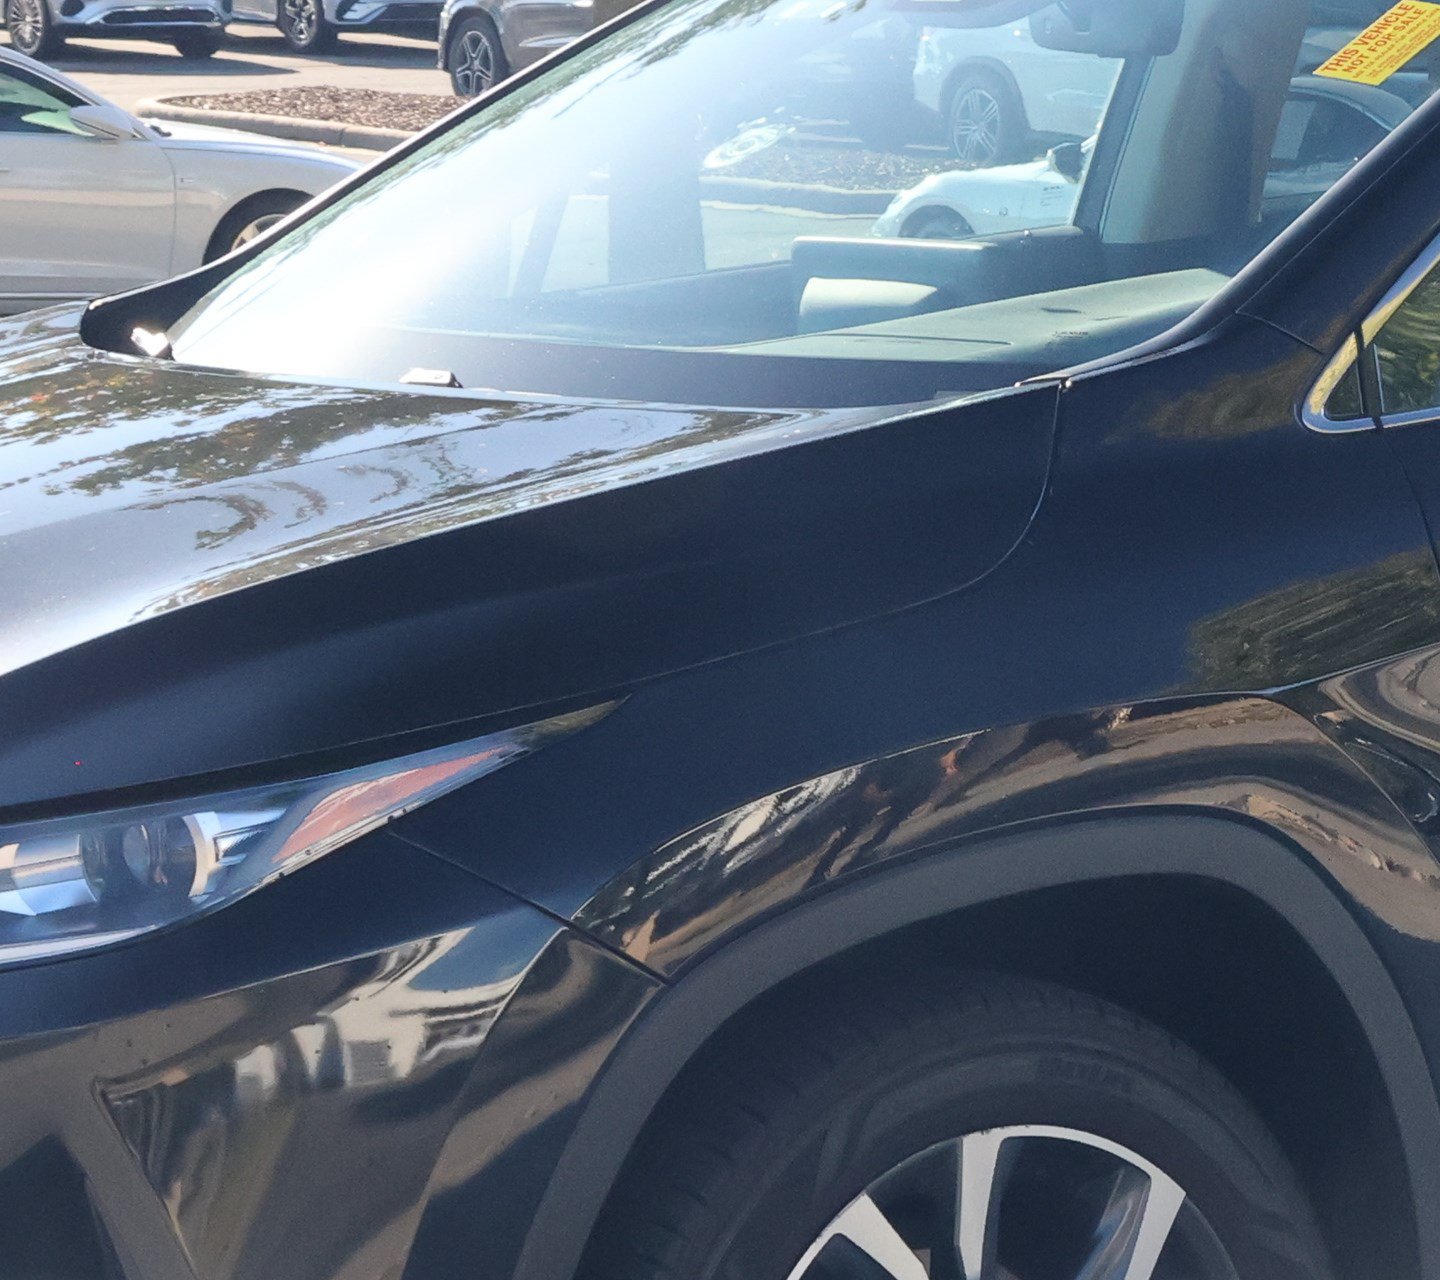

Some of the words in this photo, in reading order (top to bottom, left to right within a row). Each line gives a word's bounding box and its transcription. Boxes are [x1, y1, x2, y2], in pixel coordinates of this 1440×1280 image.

[1323, 48, 1359, 72] THIS
[1353, 3, 1416, 47] VEHICLE
[1342, 53, 1369, 73] NOT
[1368, 32, 1395, 53] FOR
[1393, 8, 1428, 32] SALE
